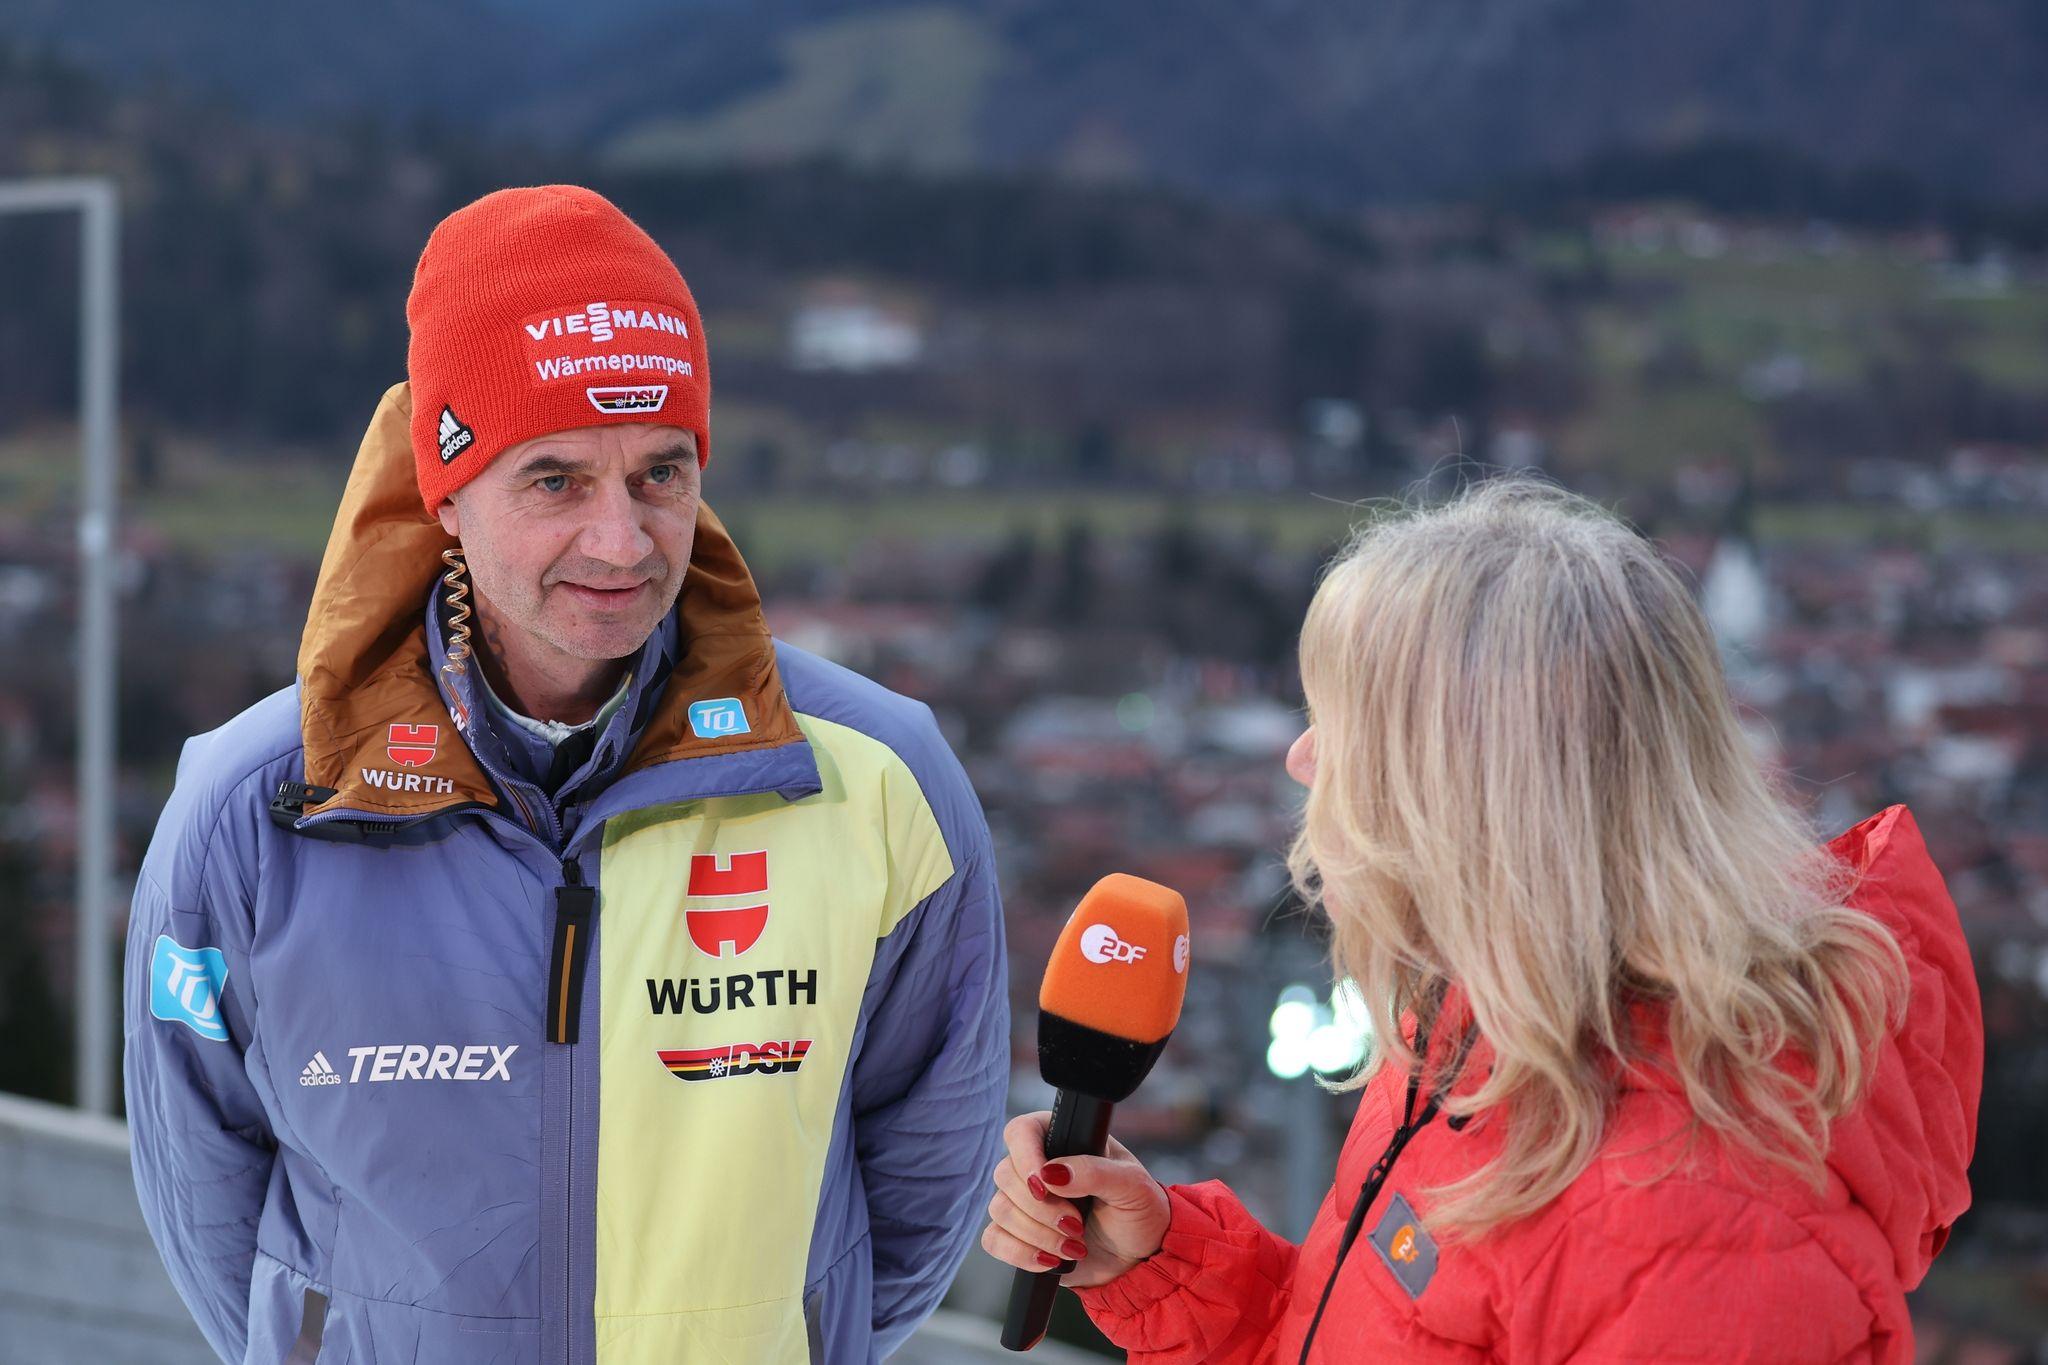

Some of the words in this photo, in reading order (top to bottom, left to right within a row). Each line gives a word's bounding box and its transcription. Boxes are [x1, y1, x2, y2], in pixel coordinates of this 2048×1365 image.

[525, 302, 688, 342] VIESSMANN
[536, 354, 692, 381] Wärmepumpen
[624, 389, 664, 409] DSV
[440, 431, 472, 460] adidas
[1099, 935, 1148, 964] ZDF
[299, 1073, 342, 1087] adidas
[347, 1045, 519, 1083] TERREX
[728, 1040, 814, 1077] DSV
